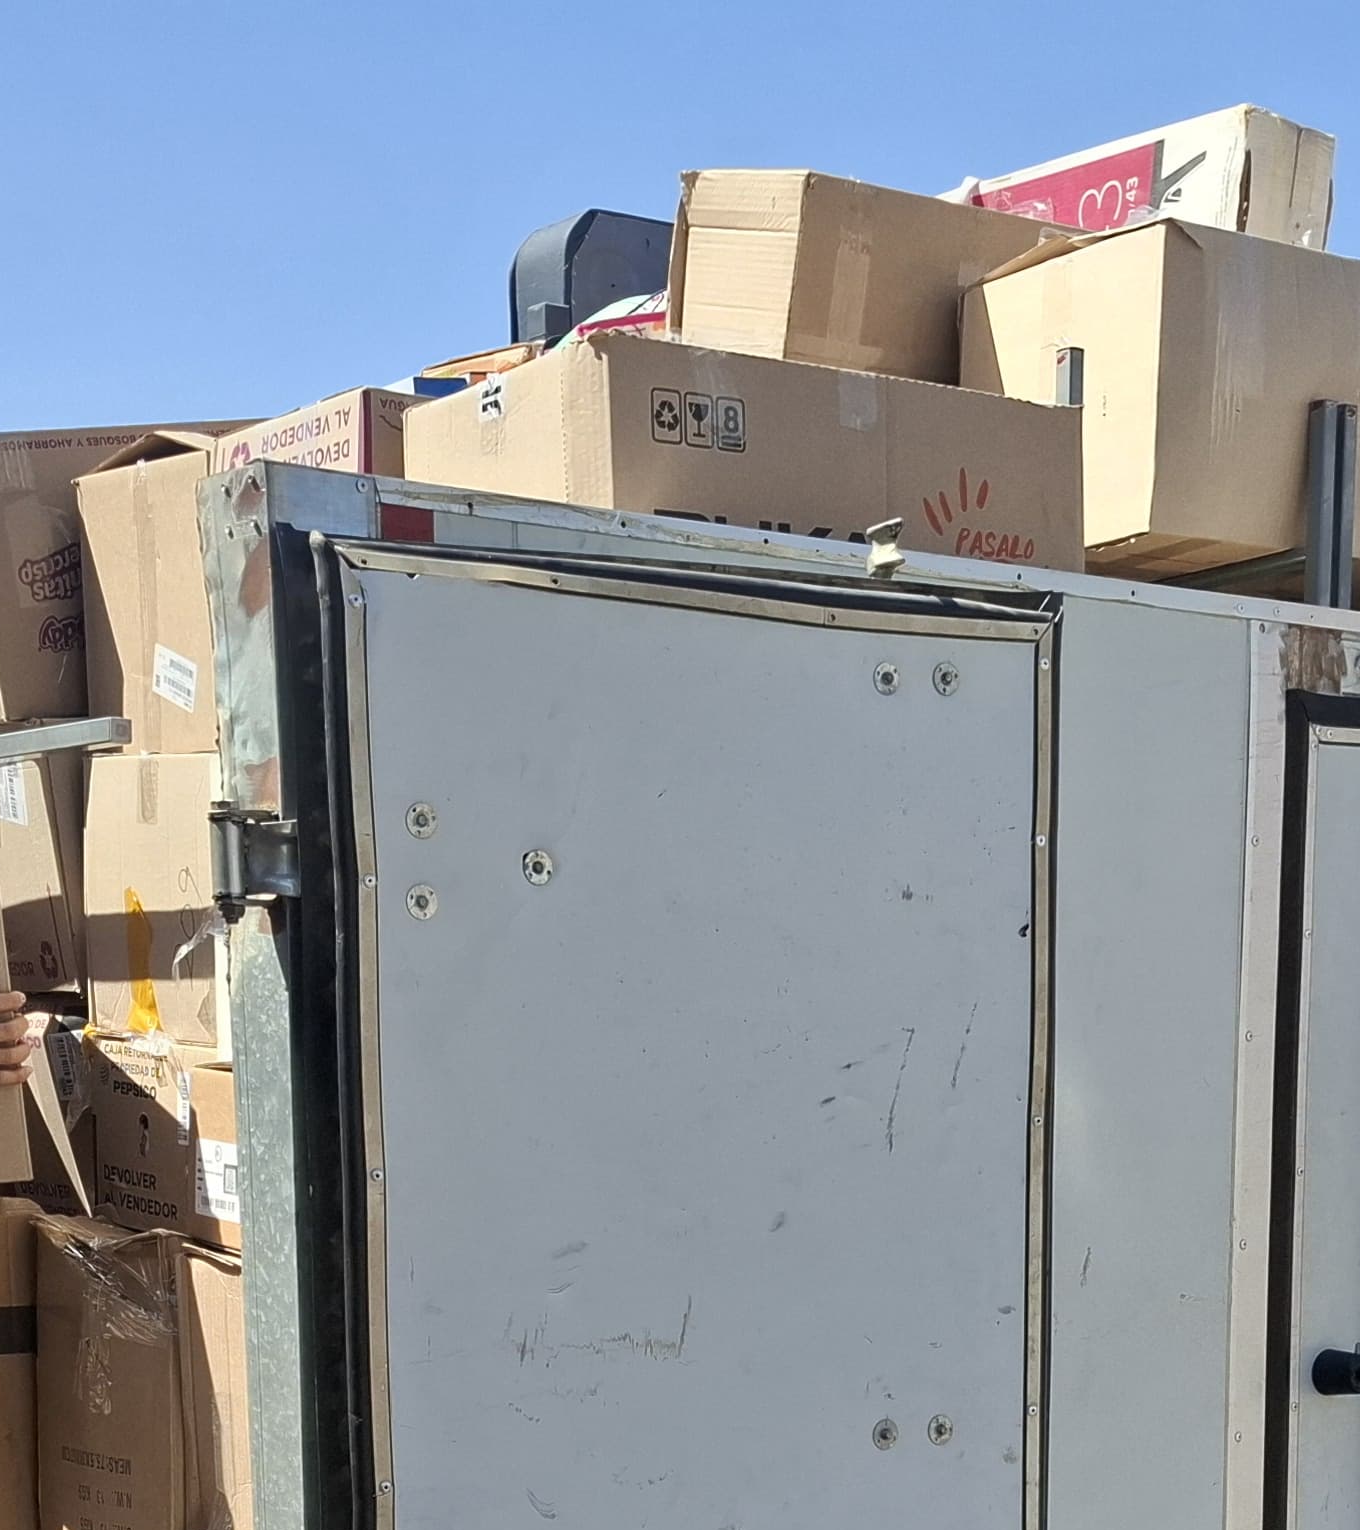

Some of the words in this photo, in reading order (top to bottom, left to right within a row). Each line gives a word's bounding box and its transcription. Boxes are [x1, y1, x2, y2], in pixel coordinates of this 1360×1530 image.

[380, 398, 410, 412] GUA
[335, 406, 351, 429] AL
[74, 438, 83, 448] Y
[86, 435, 137, 447] BOSQUES
[262, 415, 330, 453] VENDEDOR
[104, 1043, 123, 1056] CAJA
[113, 1080, 157, 1101] PEPSICO
[103, 1164, 157, 1191] DEVOLVER
[118, 1193, 178, 1221] VENDEDOR
